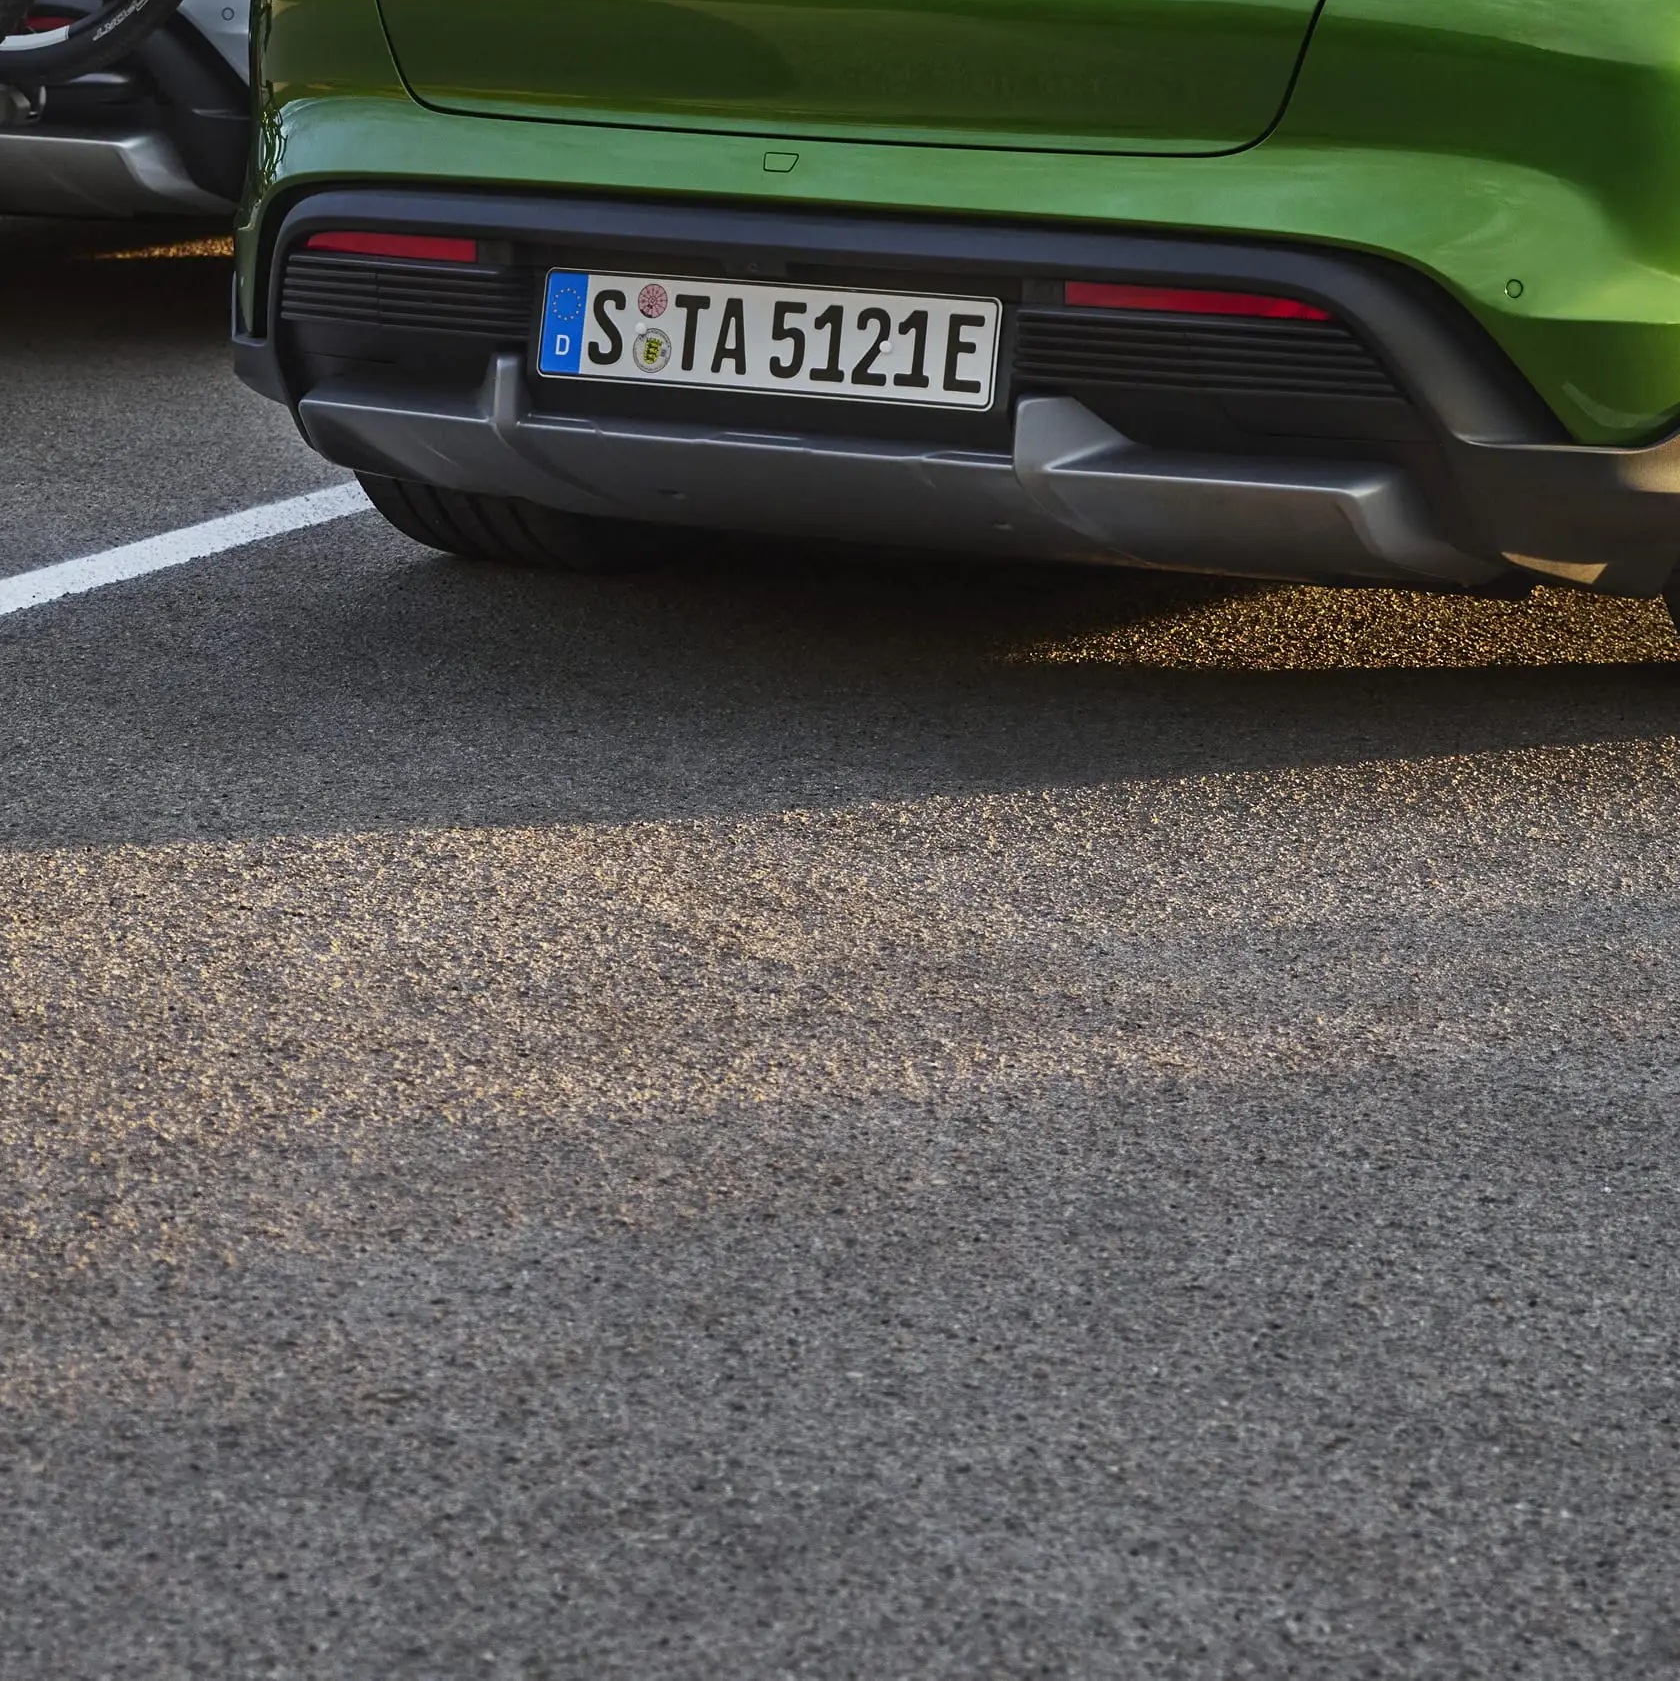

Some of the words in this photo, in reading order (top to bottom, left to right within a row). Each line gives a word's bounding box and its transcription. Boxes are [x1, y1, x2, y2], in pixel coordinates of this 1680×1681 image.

[555, 334, 569, 356] D
[587, 289, 627, 366] S
[675, 293, 747, 376] TA
[768, 300, 987, 394] 5121E
